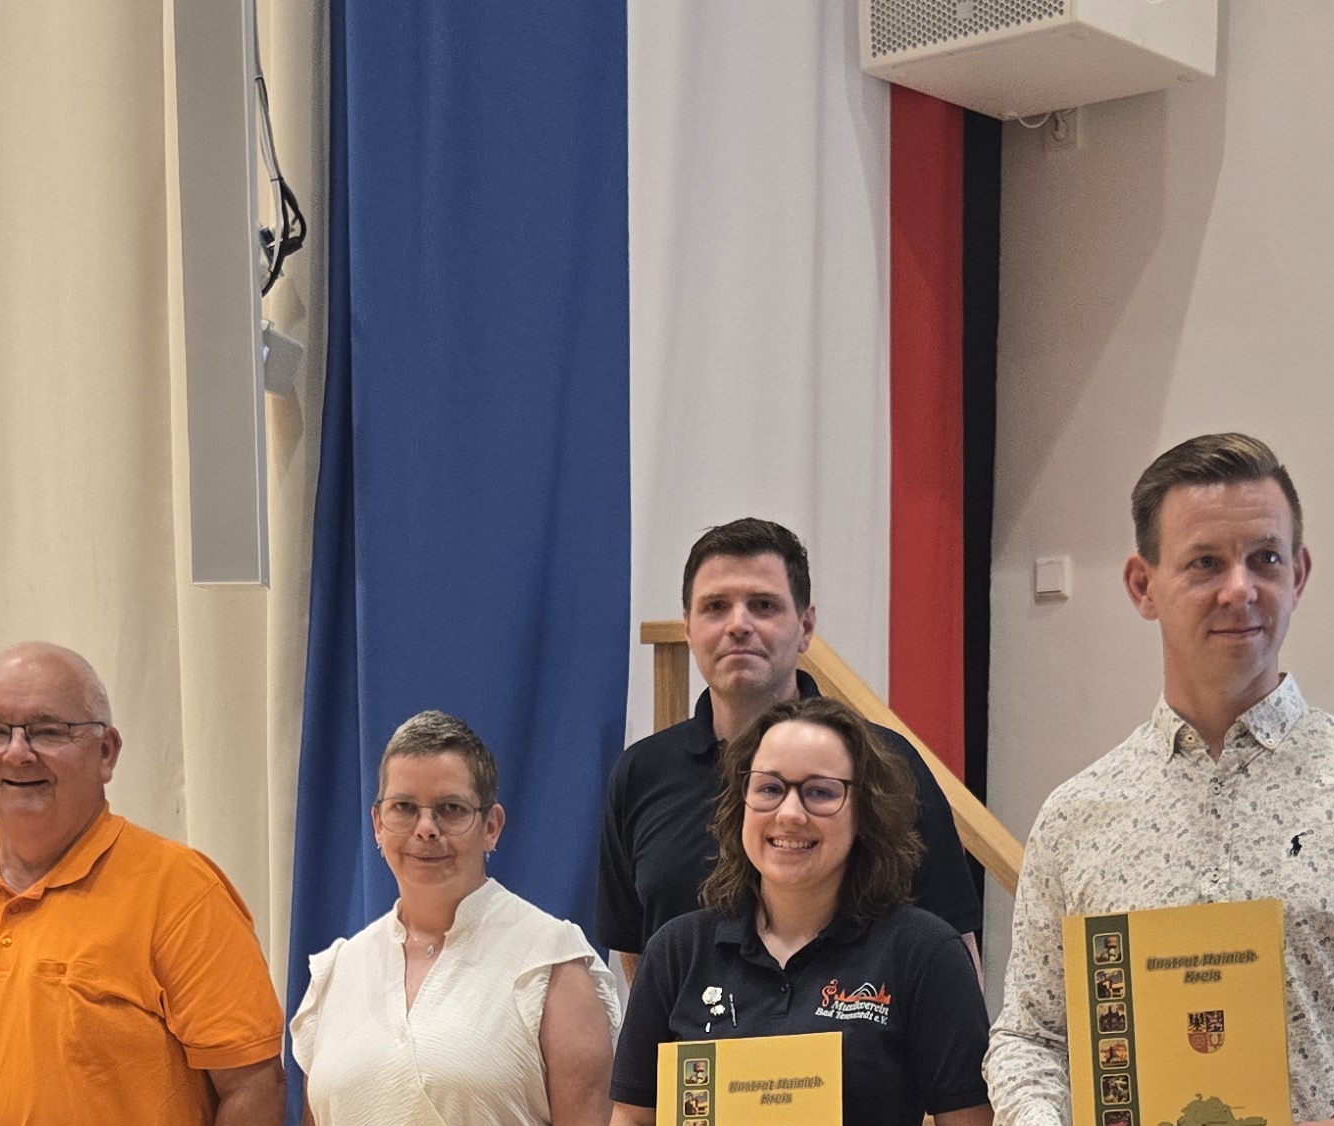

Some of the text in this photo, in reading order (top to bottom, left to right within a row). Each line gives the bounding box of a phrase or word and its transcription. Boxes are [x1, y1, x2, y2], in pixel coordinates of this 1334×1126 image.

[1184, 970, 1222, 984] Kreis
[815, 1007, 834, 1018] Bad
[831, 1001, 890, 1016] Musikverein
